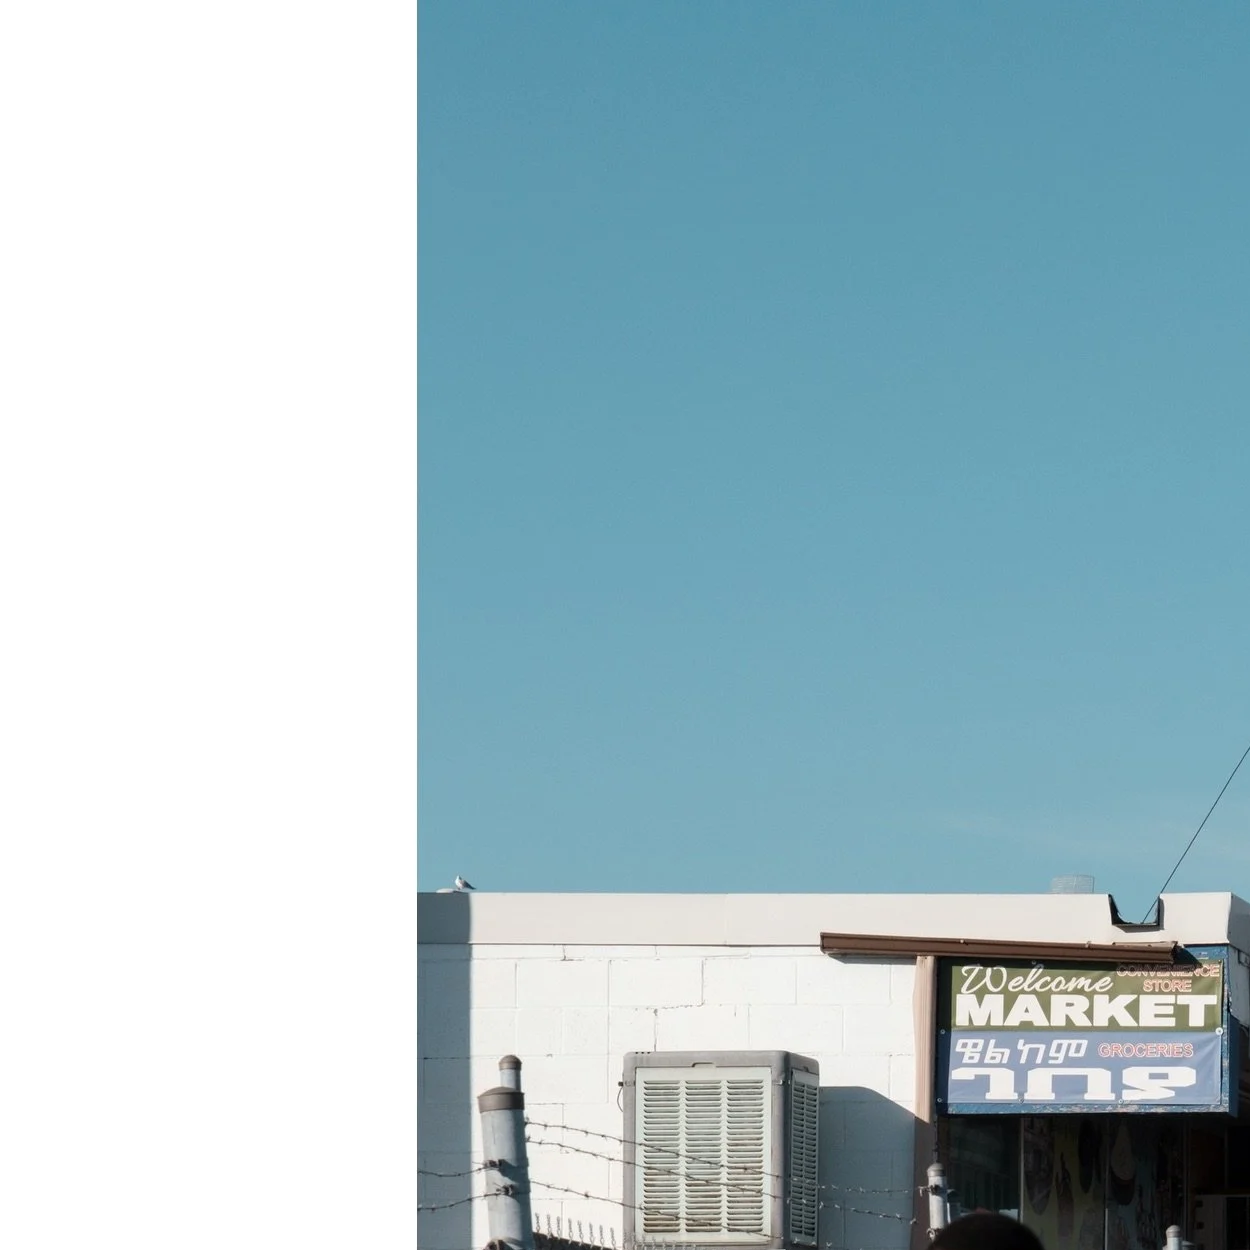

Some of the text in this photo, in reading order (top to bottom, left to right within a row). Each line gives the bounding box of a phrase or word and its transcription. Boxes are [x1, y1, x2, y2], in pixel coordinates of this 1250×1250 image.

[961, 963, 1114, 994] Welcome
[1142, 979, 1192, 992] STORE
[956, 994, 1217, 1027] MARKET
[1098, 1042, 1194, 1058] GROCERIES
